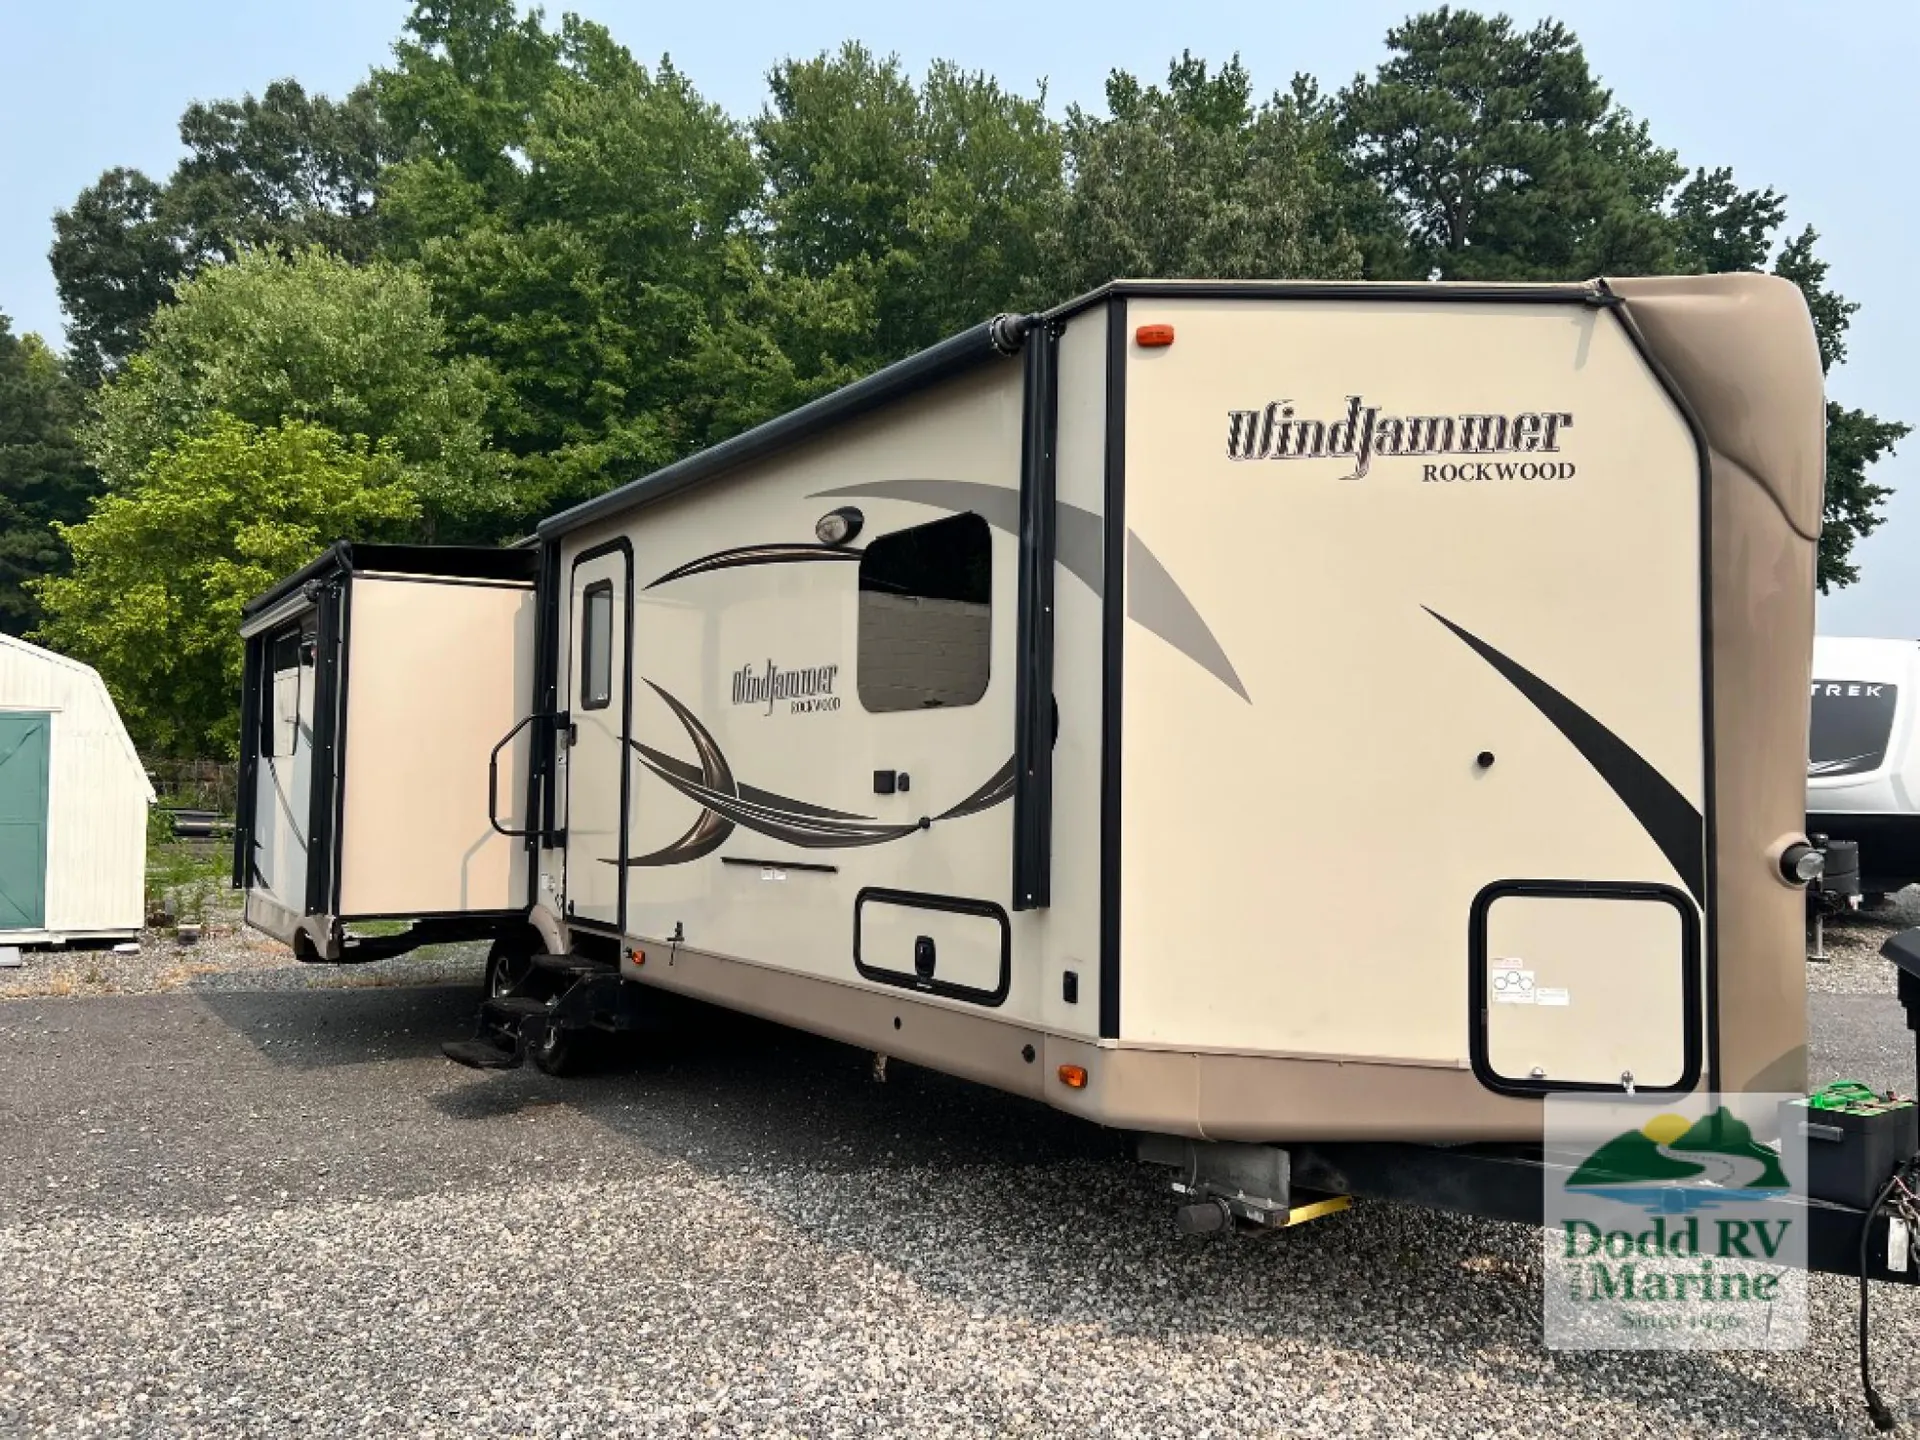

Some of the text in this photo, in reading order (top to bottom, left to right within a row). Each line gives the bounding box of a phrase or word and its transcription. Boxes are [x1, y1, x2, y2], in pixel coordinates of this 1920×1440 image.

[1422, 463, 1576, 482] ROCKWOOD
[1811, 684, 1883, 697] TREK
[790, 697, 841, 715] ROCKWOOD
